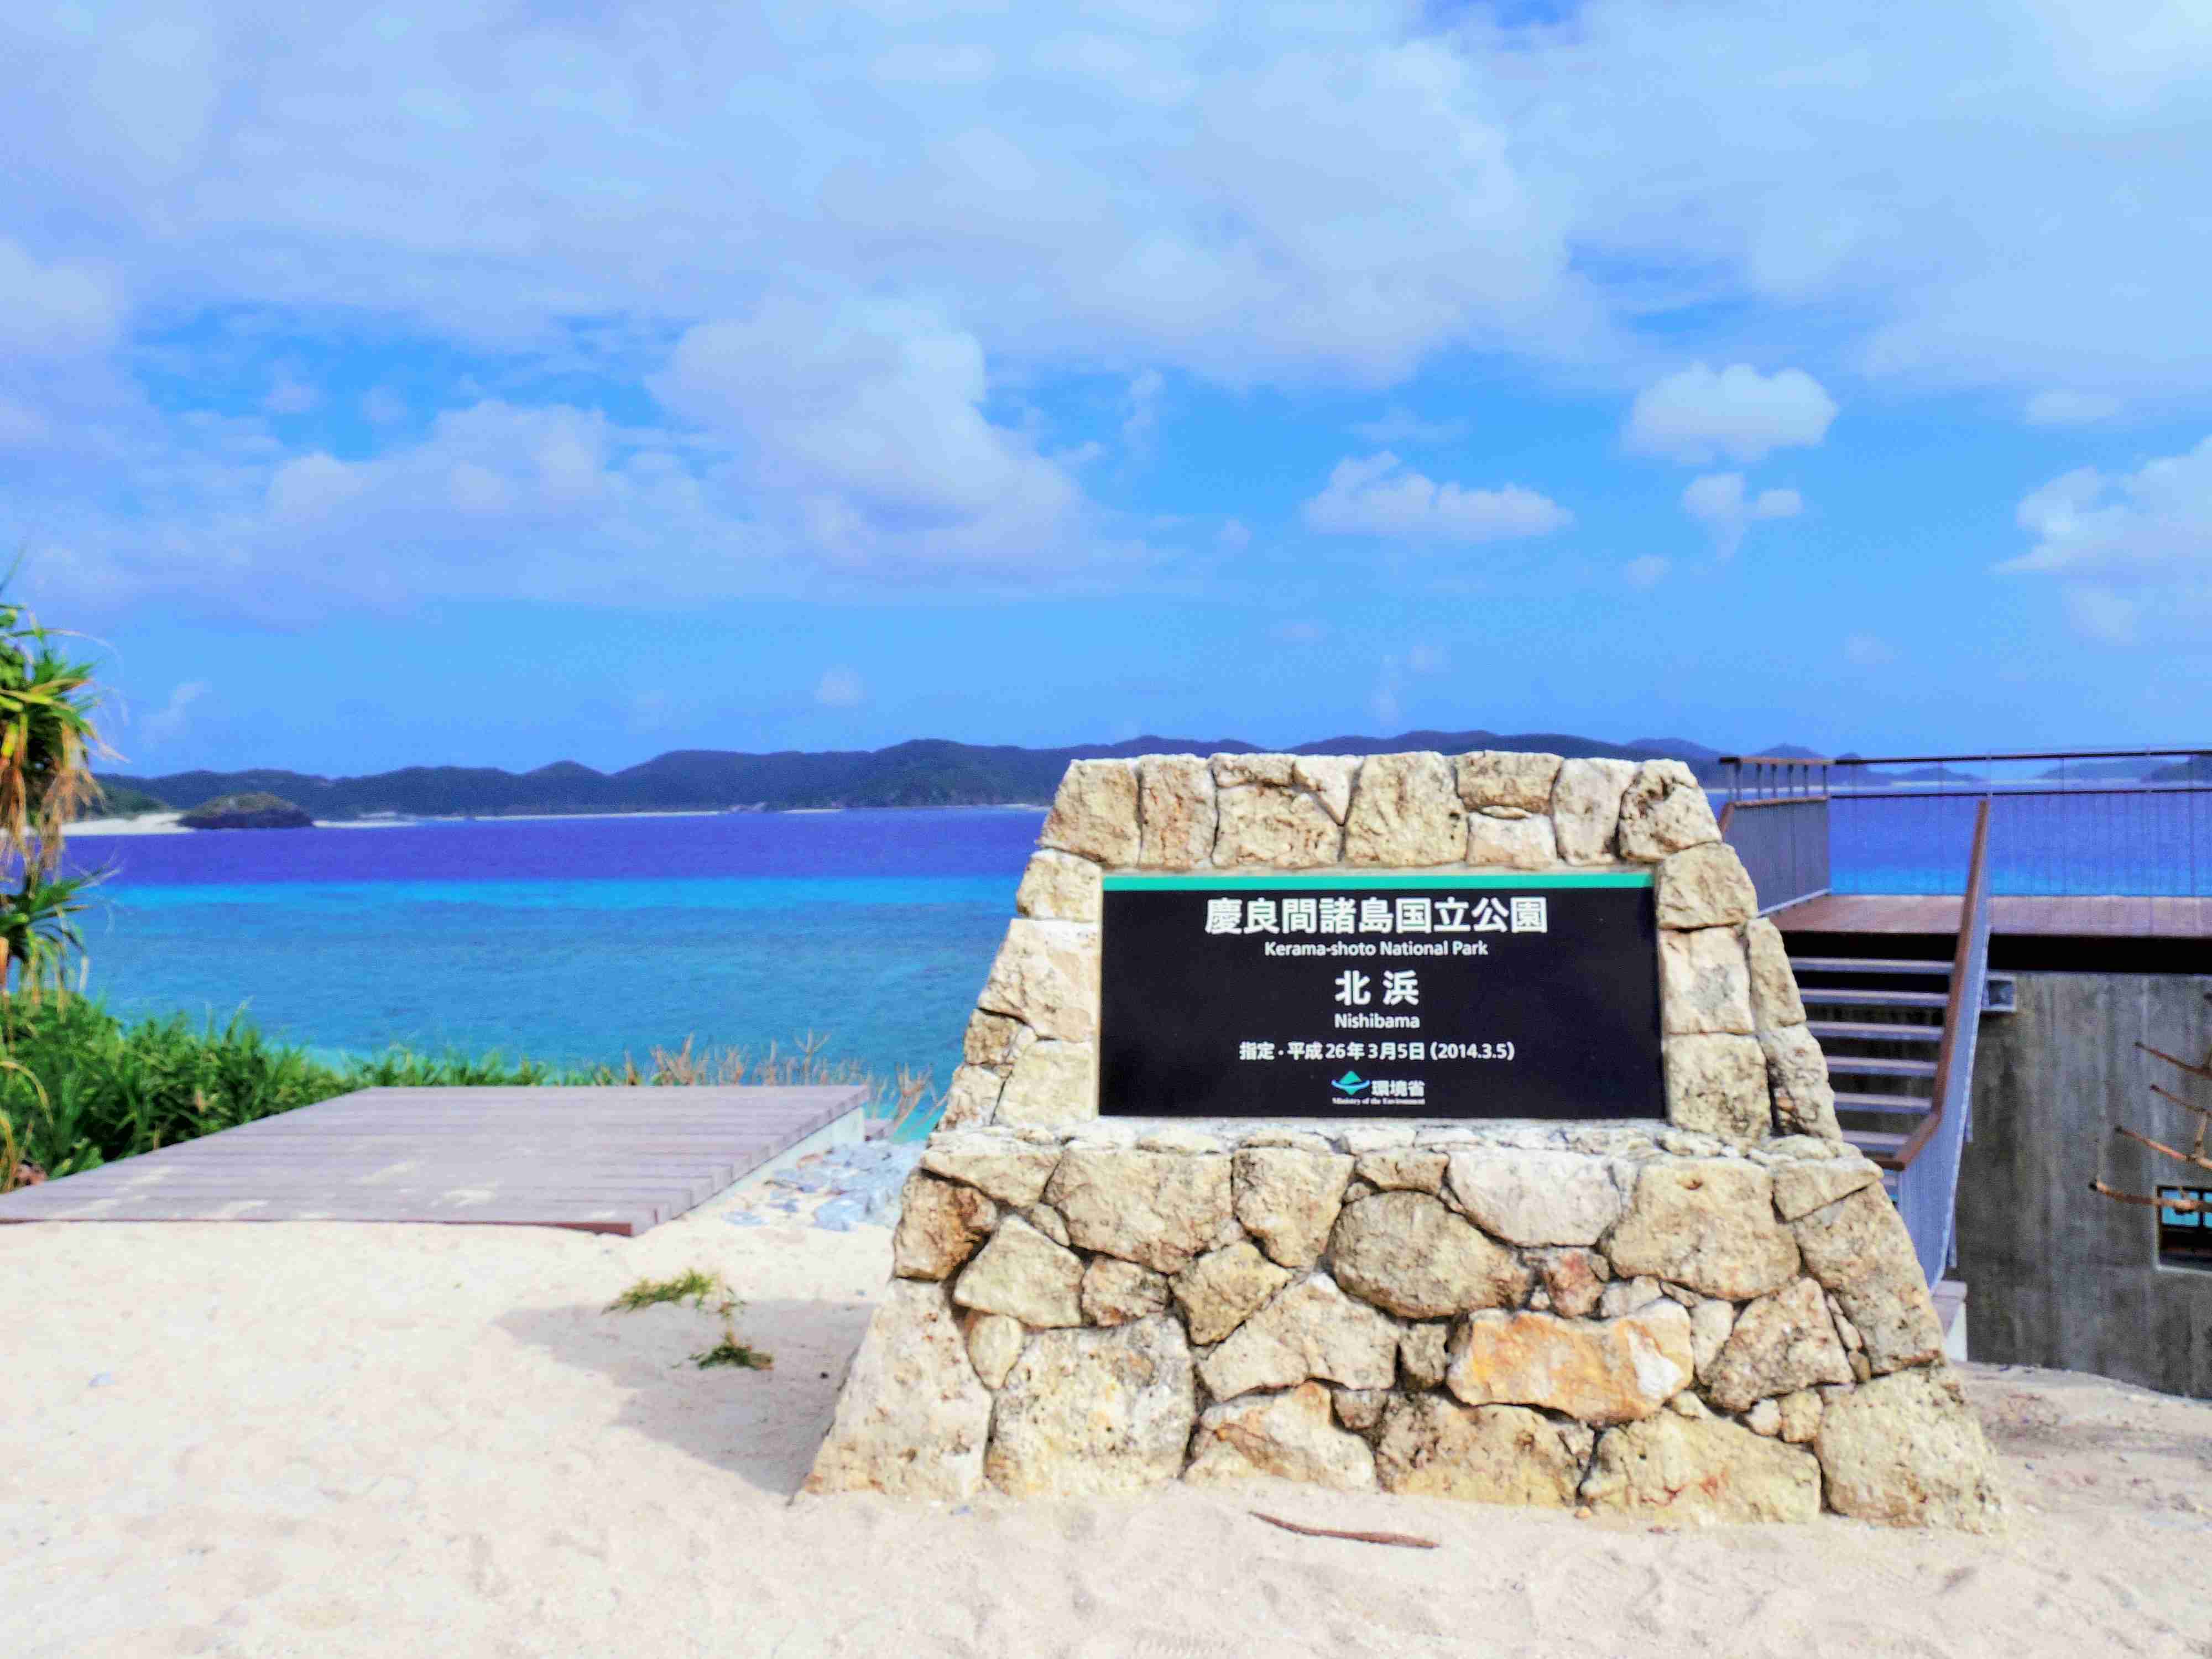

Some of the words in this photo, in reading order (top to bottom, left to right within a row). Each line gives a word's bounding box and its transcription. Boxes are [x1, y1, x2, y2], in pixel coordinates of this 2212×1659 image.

[1205, 896, 1548, 935] 慶良間諸島国立公園
[1264, 940, 1376, 956] Kerama-shoto
[1380, 940, 1448, 956] National
[1452, 940, 1488, 956] Park
[1334, 1012, 1420, 1029] Nishibama
[1371, 1080, 1425, 1097] 環境省
